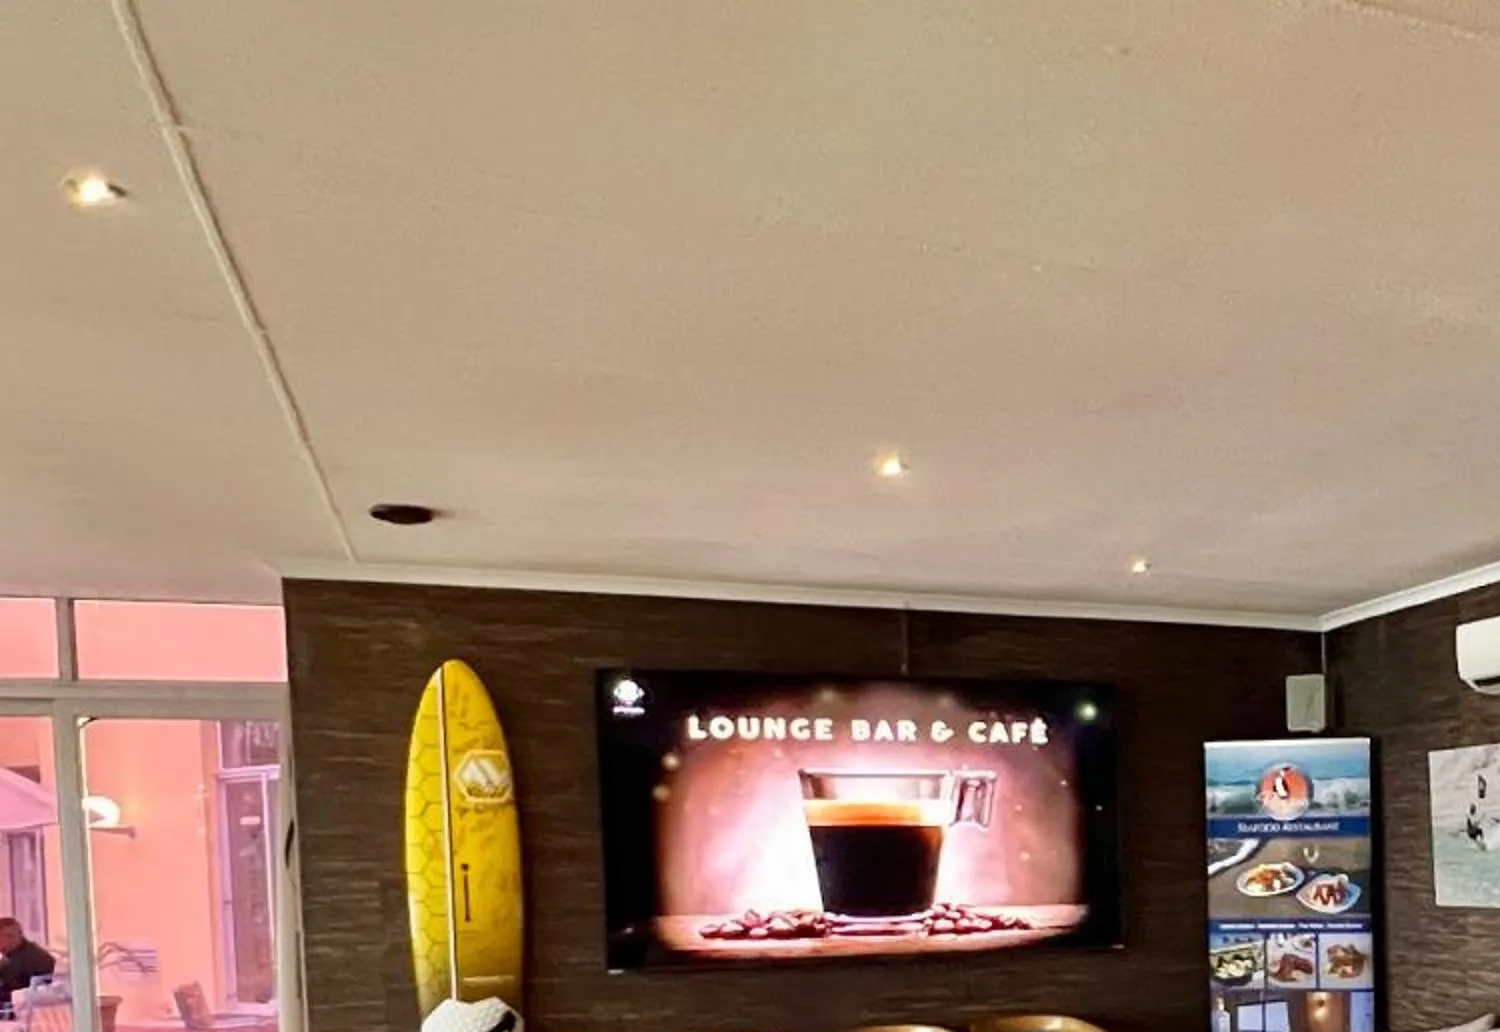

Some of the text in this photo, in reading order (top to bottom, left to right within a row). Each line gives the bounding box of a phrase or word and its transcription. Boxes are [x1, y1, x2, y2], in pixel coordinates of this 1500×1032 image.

[688, 716, 1049, 745] LOUNGE BAR & CAFÉ
